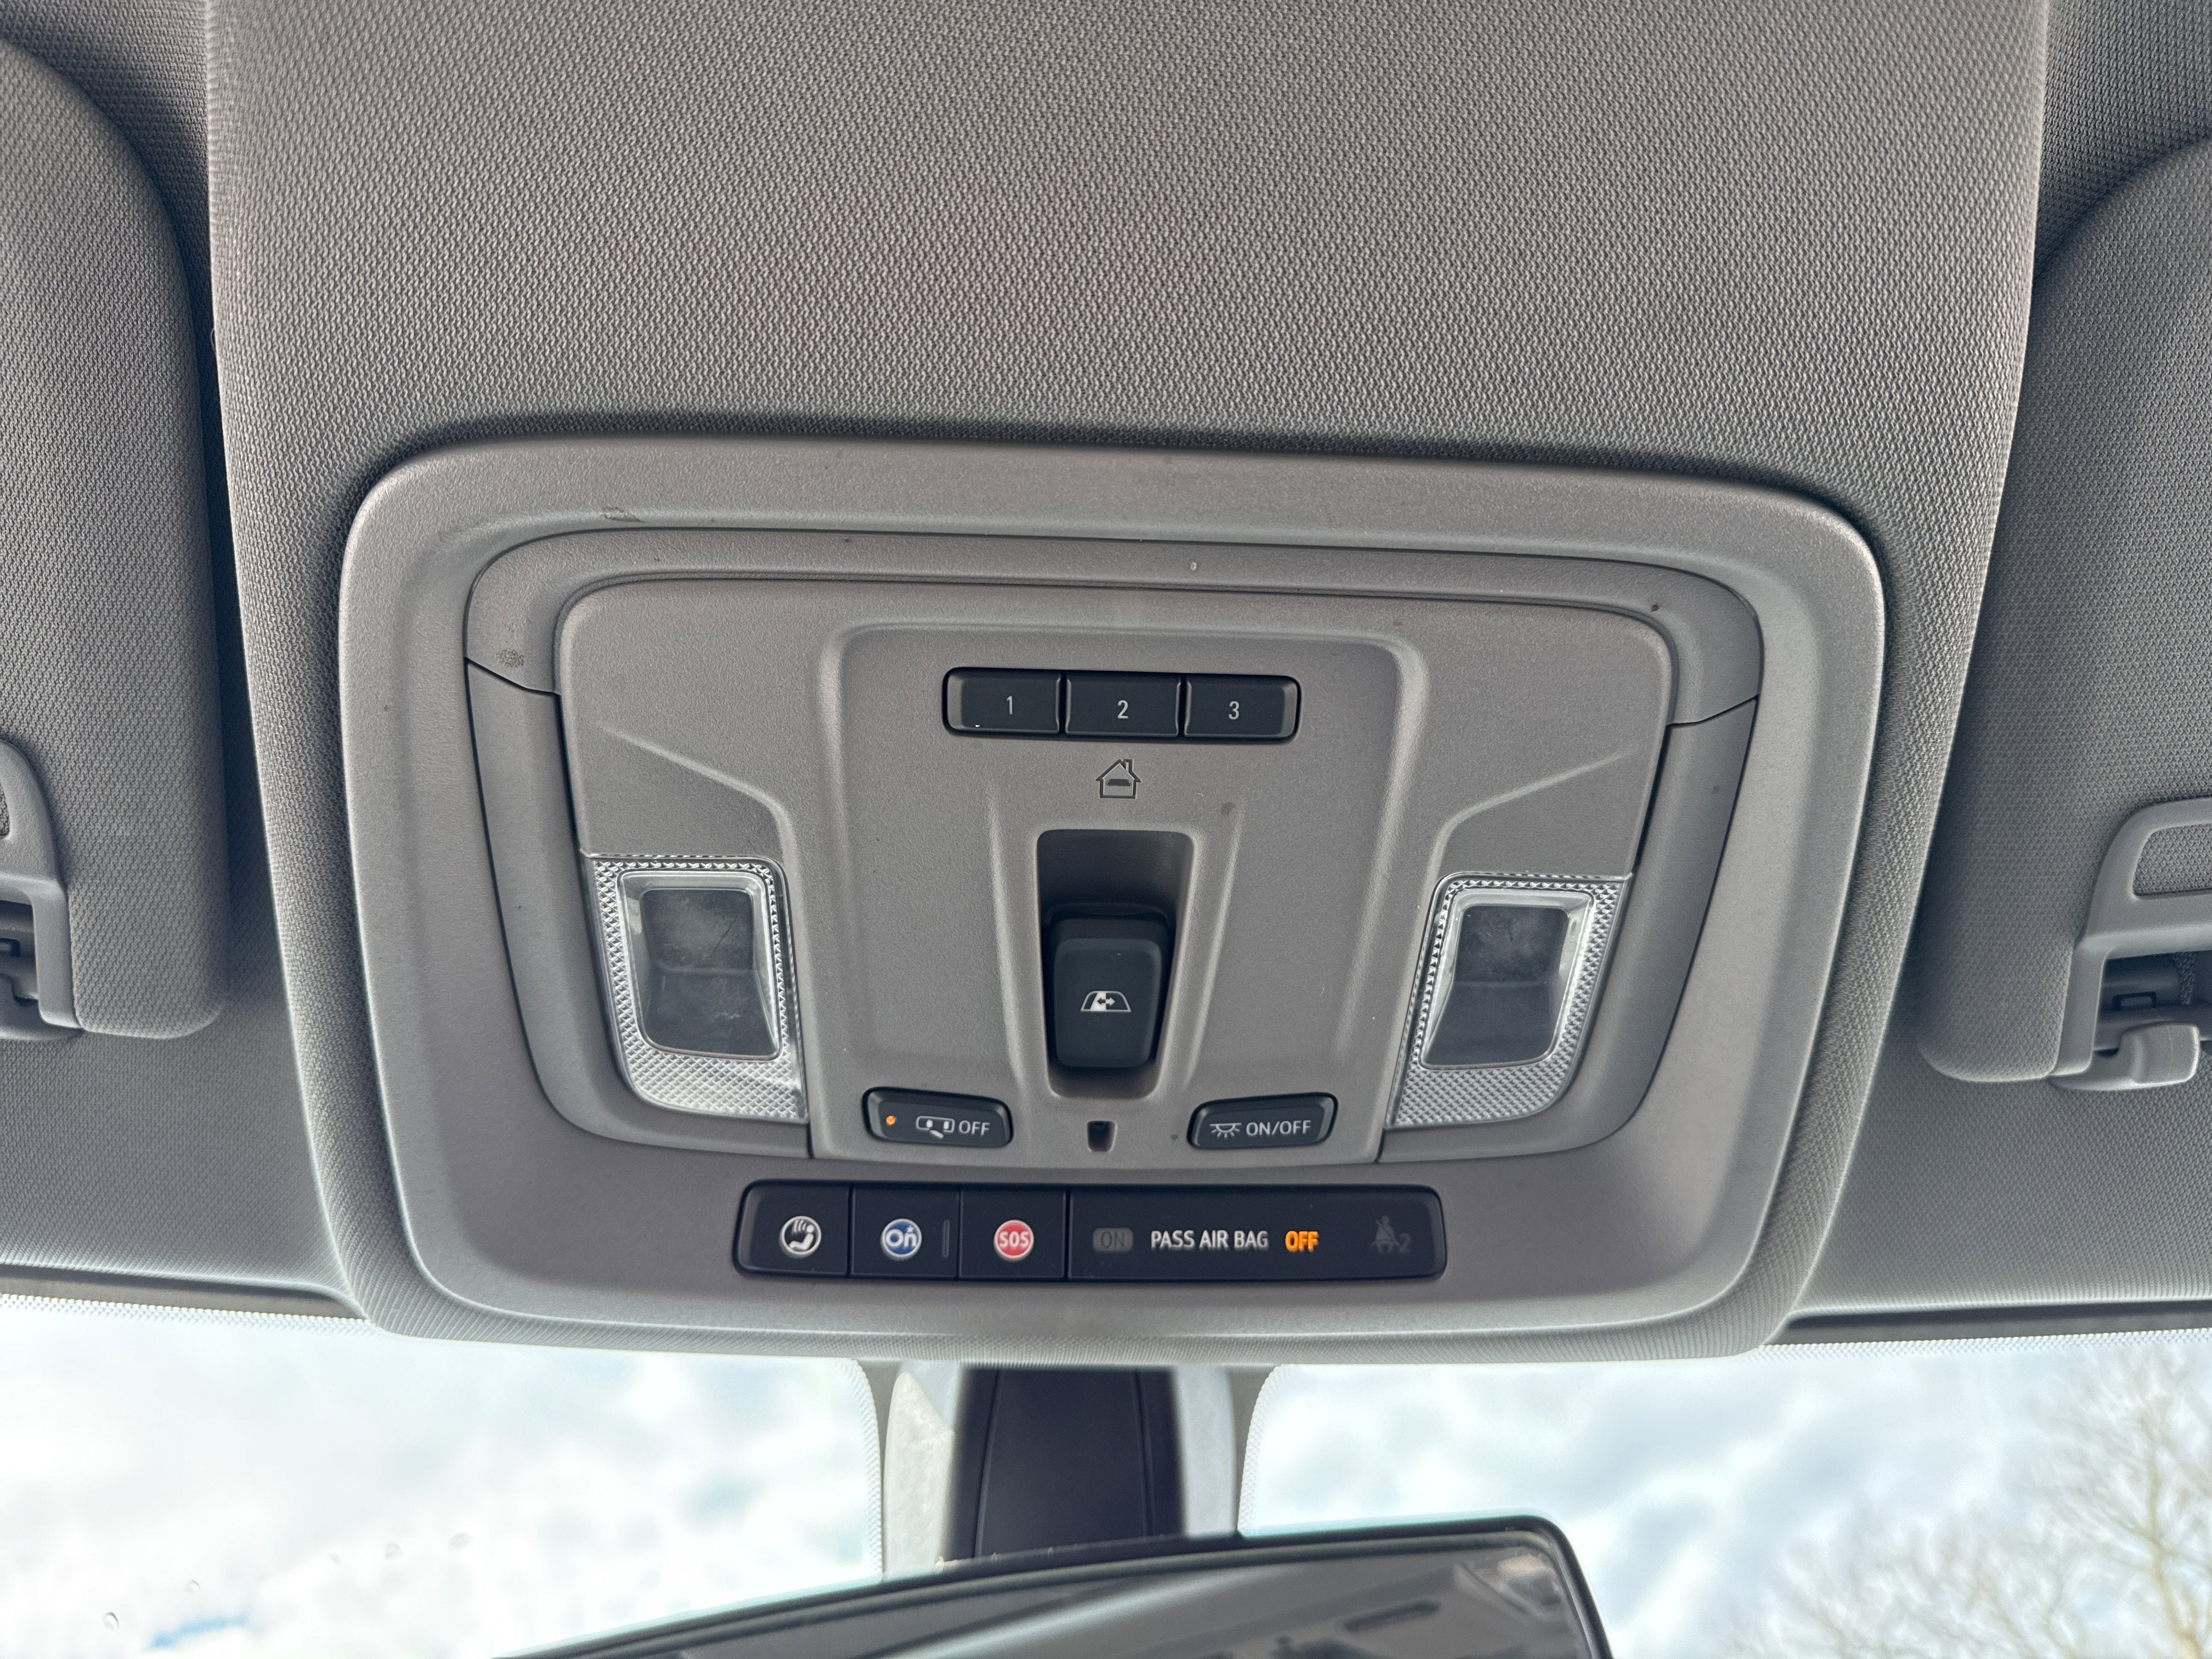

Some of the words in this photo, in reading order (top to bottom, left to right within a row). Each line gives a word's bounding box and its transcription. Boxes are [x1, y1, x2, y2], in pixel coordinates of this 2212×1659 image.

[1006, 696, 1013, 715] 1
[1117, 700, 1128, 719] 2
[1228, 701, 1239, 720] 3
[958, 1120, 990, 1136] OFF
[1246, 1120, 1311, 1136] ON/OFF
[885, 1227, 917, 1248] On
[1000, 1231, 1029, 1249] SOS
[1101, 1231, 1125, 1247] ON
[1151, 1230, 1194, 1250] PASS
[1199, 1230, 1229, 1250] AIR
[1234, 1231, 1268, 1250] BAG
[1284, 1231, 1319, 1252] OFF
[1398, 1232, 1410, 1253] 2
